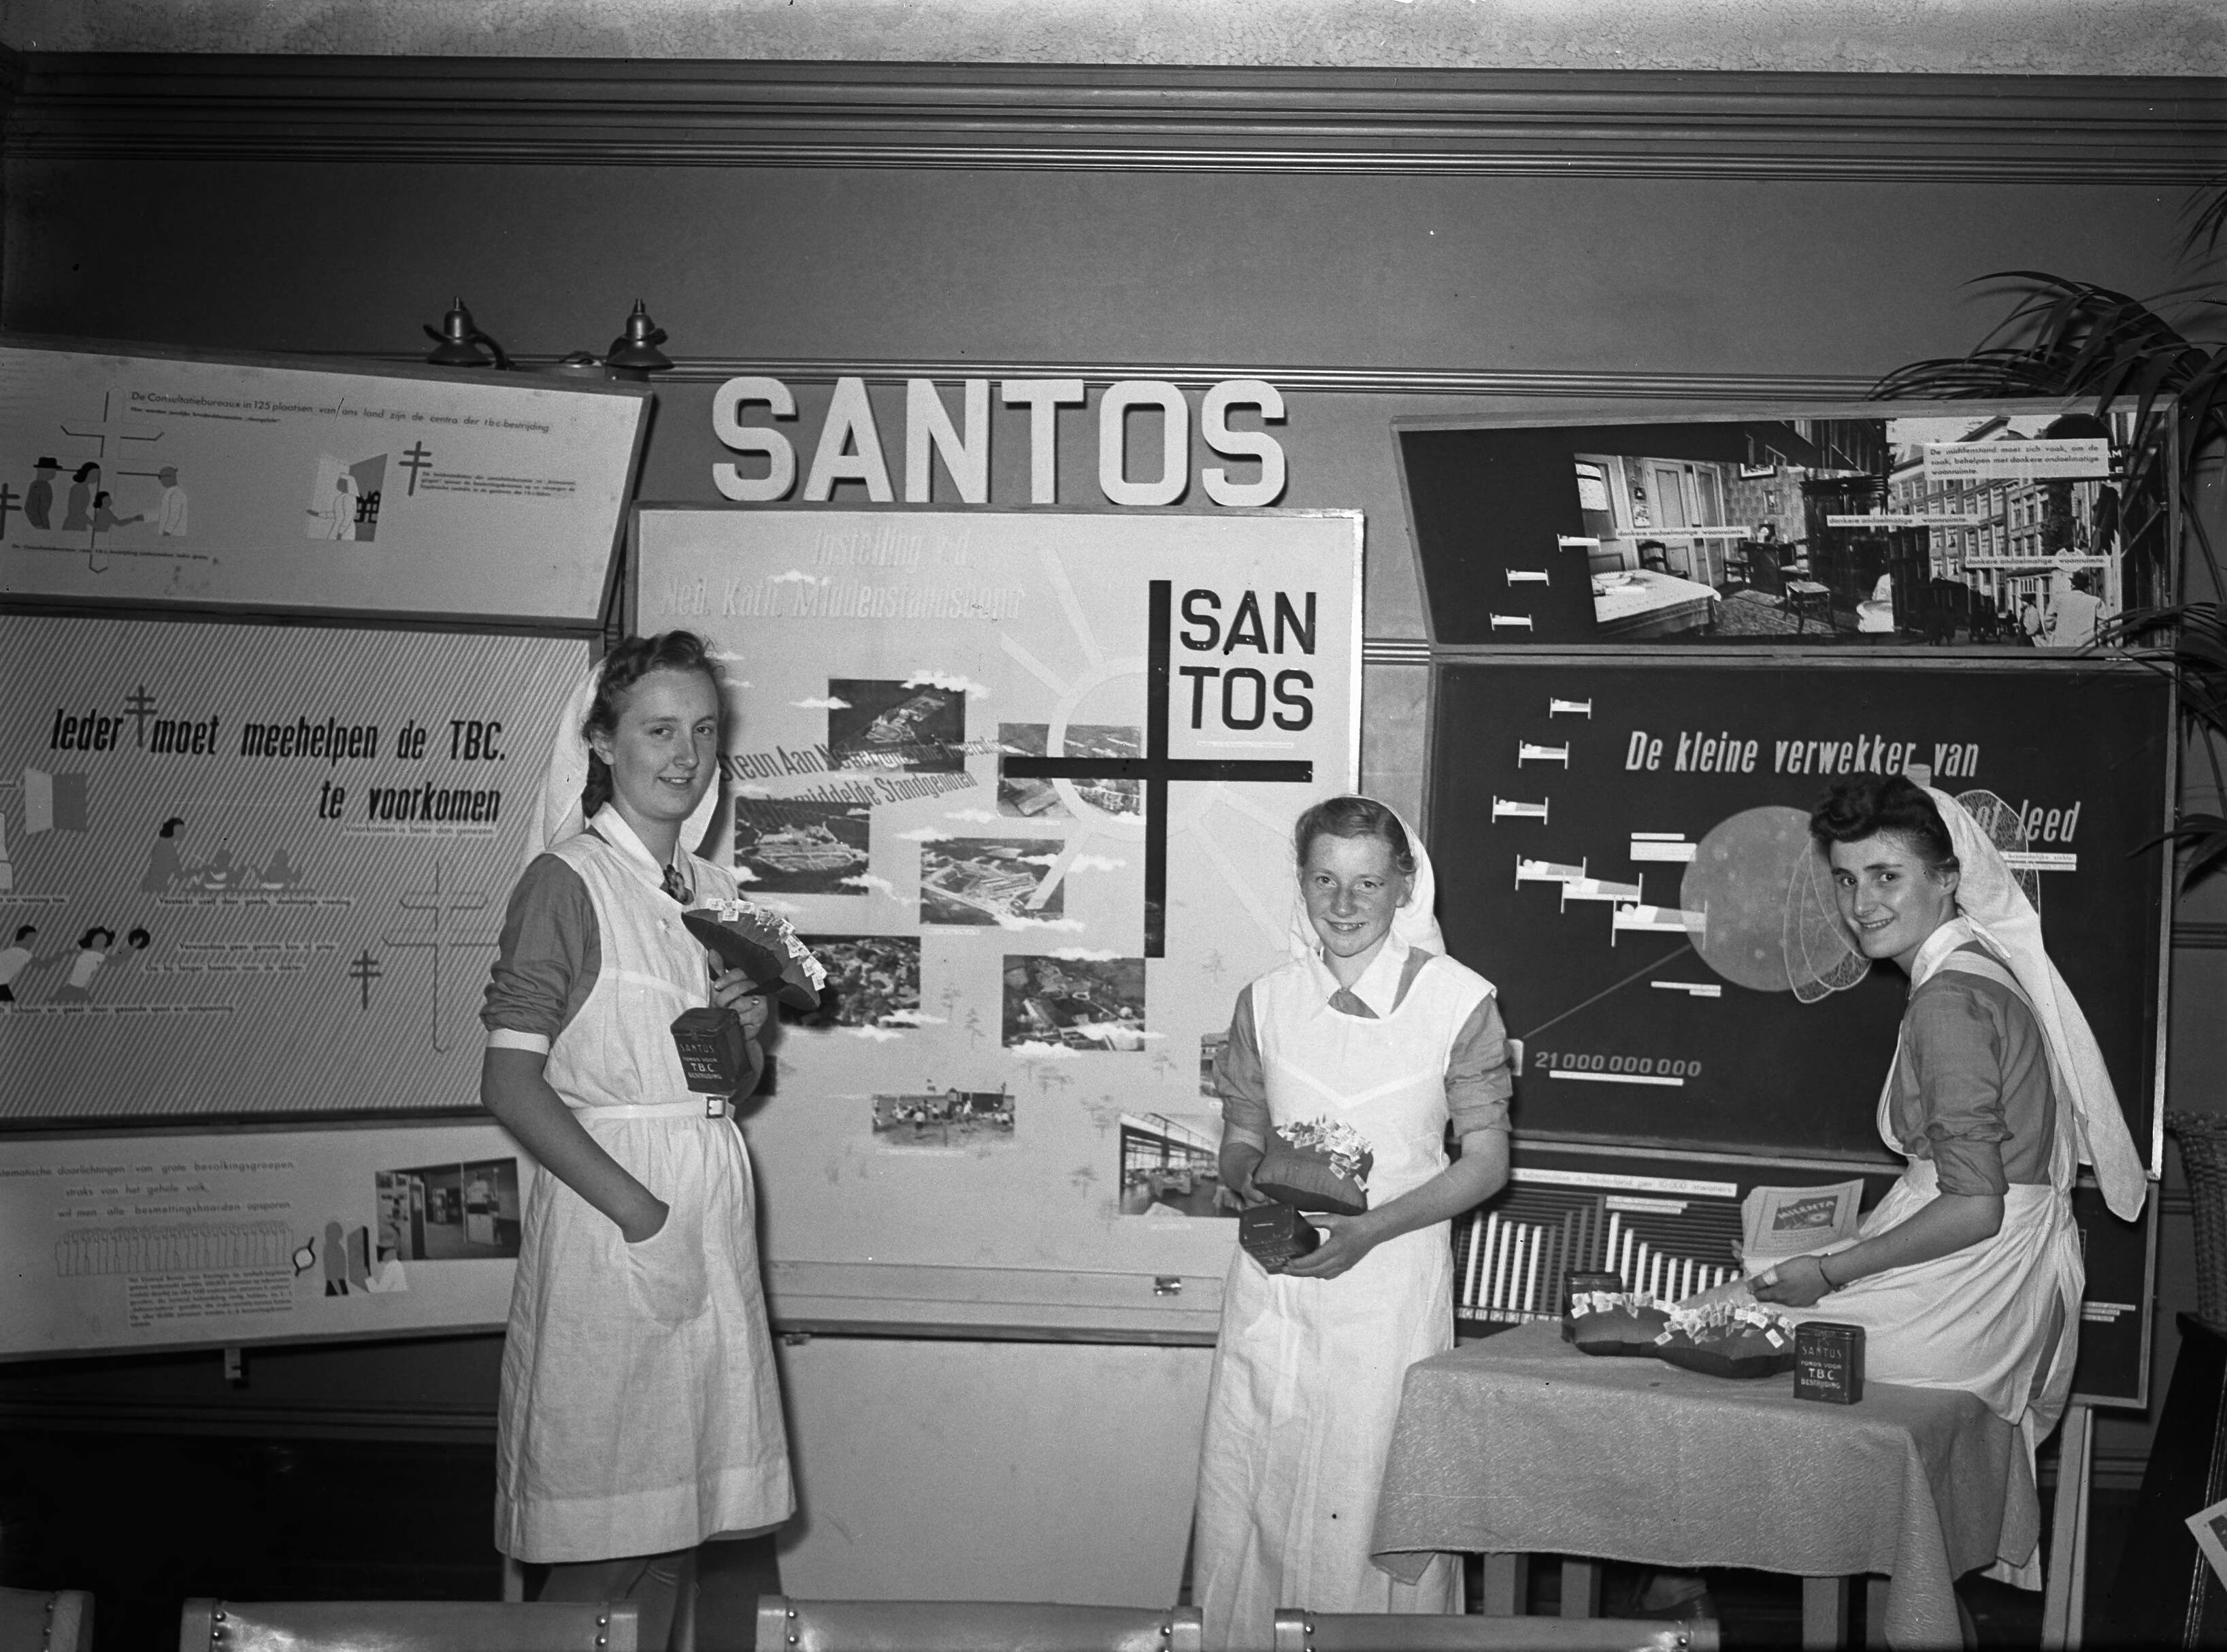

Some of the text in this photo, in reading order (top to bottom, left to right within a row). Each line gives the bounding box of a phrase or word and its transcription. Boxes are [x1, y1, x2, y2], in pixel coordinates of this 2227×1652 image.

[131, 392, 145, 401] De
[254, 400, 271, 410] 125
[273, 402, 313, 412] plaatsen
[363, 408, 384, 418] land
[412, 412, 424, 421] de
[463, 416, 480, 425] der
[712, 377, 1285, 506] SANTOS
[792, 578, 1022, 620] Middenstandsbond
[1180, 589, 1316, 655] SAN
[1179, 665, 1314, 731] TOS
[150, 715, 219, 755] moet
[240, 716, 378, 767] meehelpen
[396, 720, 426, 760] de
[450, 720, 505, 761] TBC.
[776, 745, 823, 778] Aan
[1626, 731, 1979, 777] De kleine verwekker van
[319, 781, 501, 822] te voorkomen
[876, 771, 978, 804] Standgenoten
[2015, 799, 2081, 842] leed
